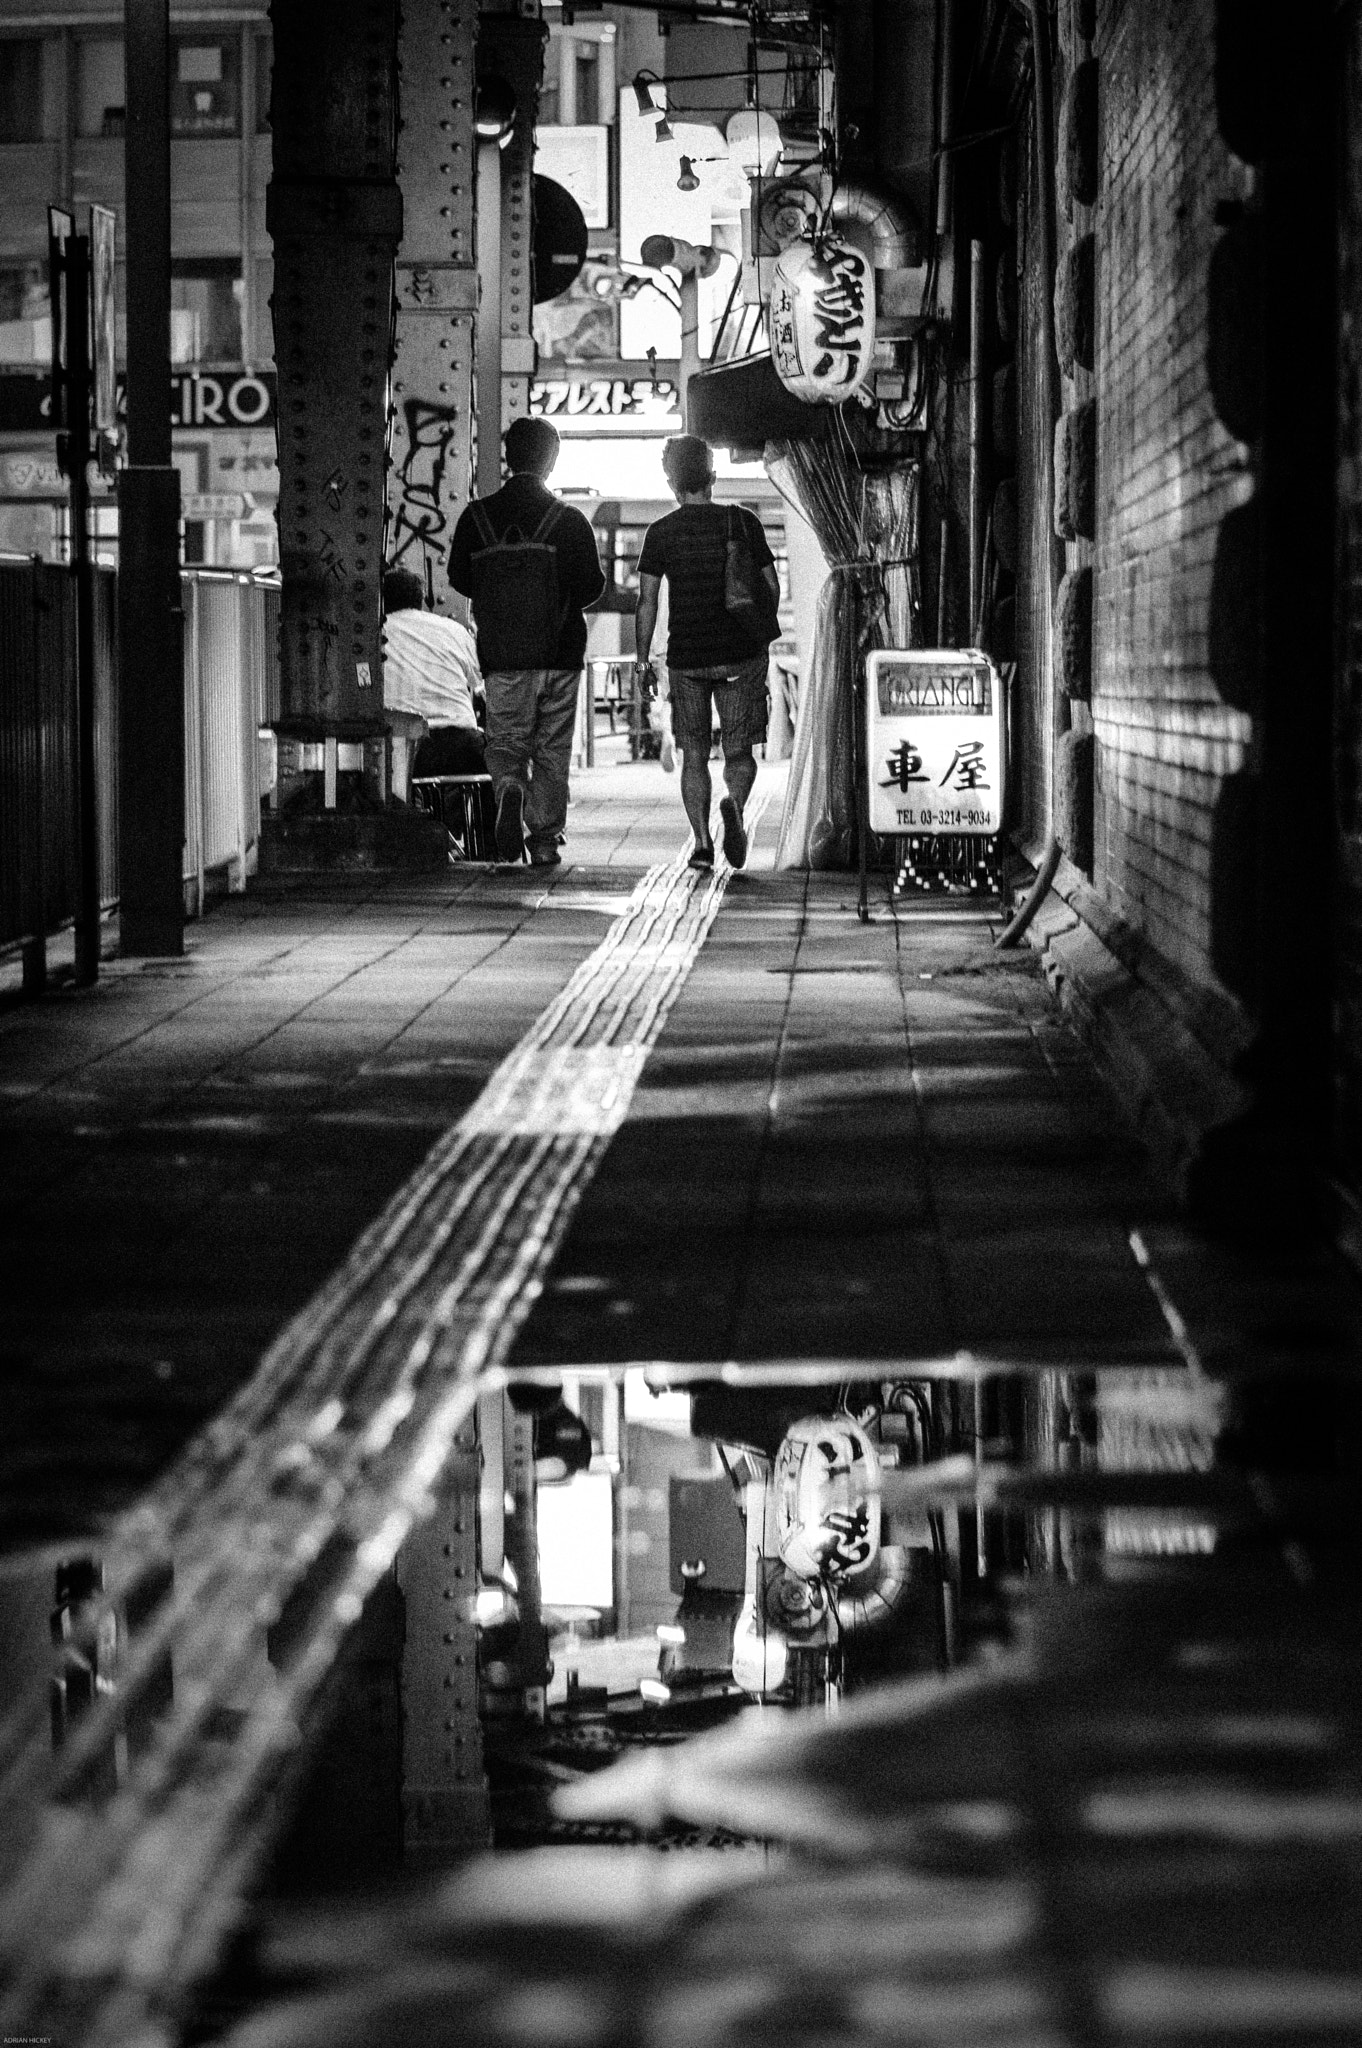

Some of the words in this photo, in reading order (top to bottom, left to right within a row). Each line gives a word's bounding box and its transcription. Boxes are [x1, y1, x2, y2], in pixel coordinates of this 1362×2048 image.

[808, 246, 865, 385] やきとり
[878, 739, 990, 793] 車屋
[897, 809, 916, 825] TEL
[920, 809, 990, 825] 03-3214-9034
